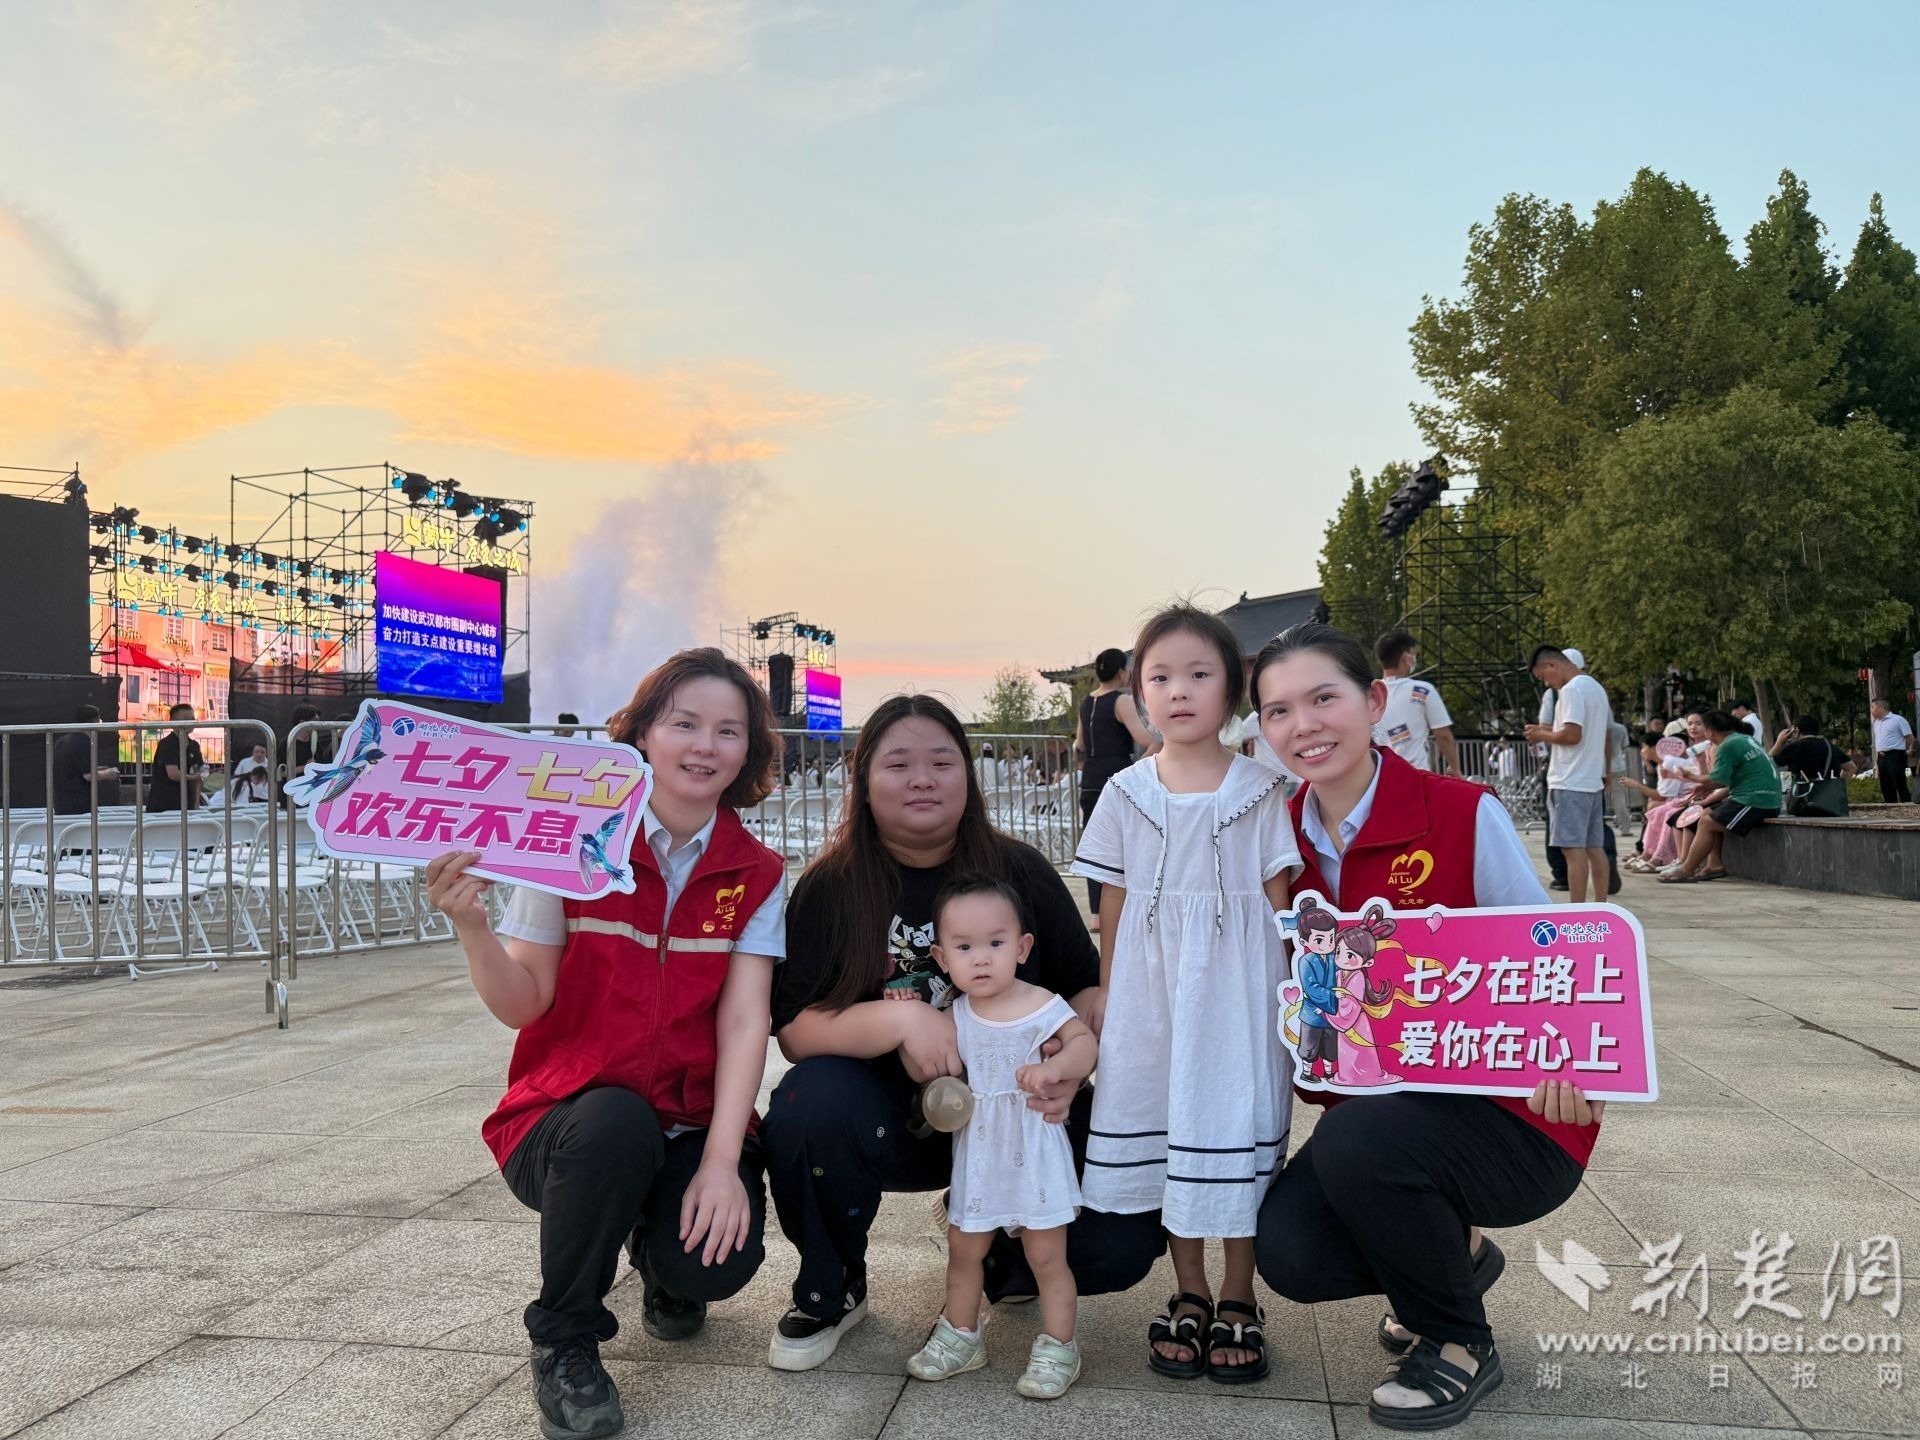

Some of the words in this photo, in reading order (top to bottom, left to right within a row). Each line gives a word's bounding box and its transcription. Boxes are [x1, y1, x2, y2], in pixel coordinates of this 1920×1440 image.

[382, 625, 497, 658] 奋力打造支点建设重要增长极
[417, 721, 461, 734] 湖北交投
[393, 740, 511, 794] 七夕
[516, 751, 646, 810] 七夕
[333, 791, 580, 858] 欢乐不息
[1387, 876, 1398, 885] Ai
[1400, 875, 1413, 884] Lu
[1560, 922, 1612, 935] 湖北交投
[1568, 934, 1605, 943] HBCI
[1403, 953, 1624, 1006] 七夕在路上
[1398, 1020, 1621, 1073] 爱你在心上
